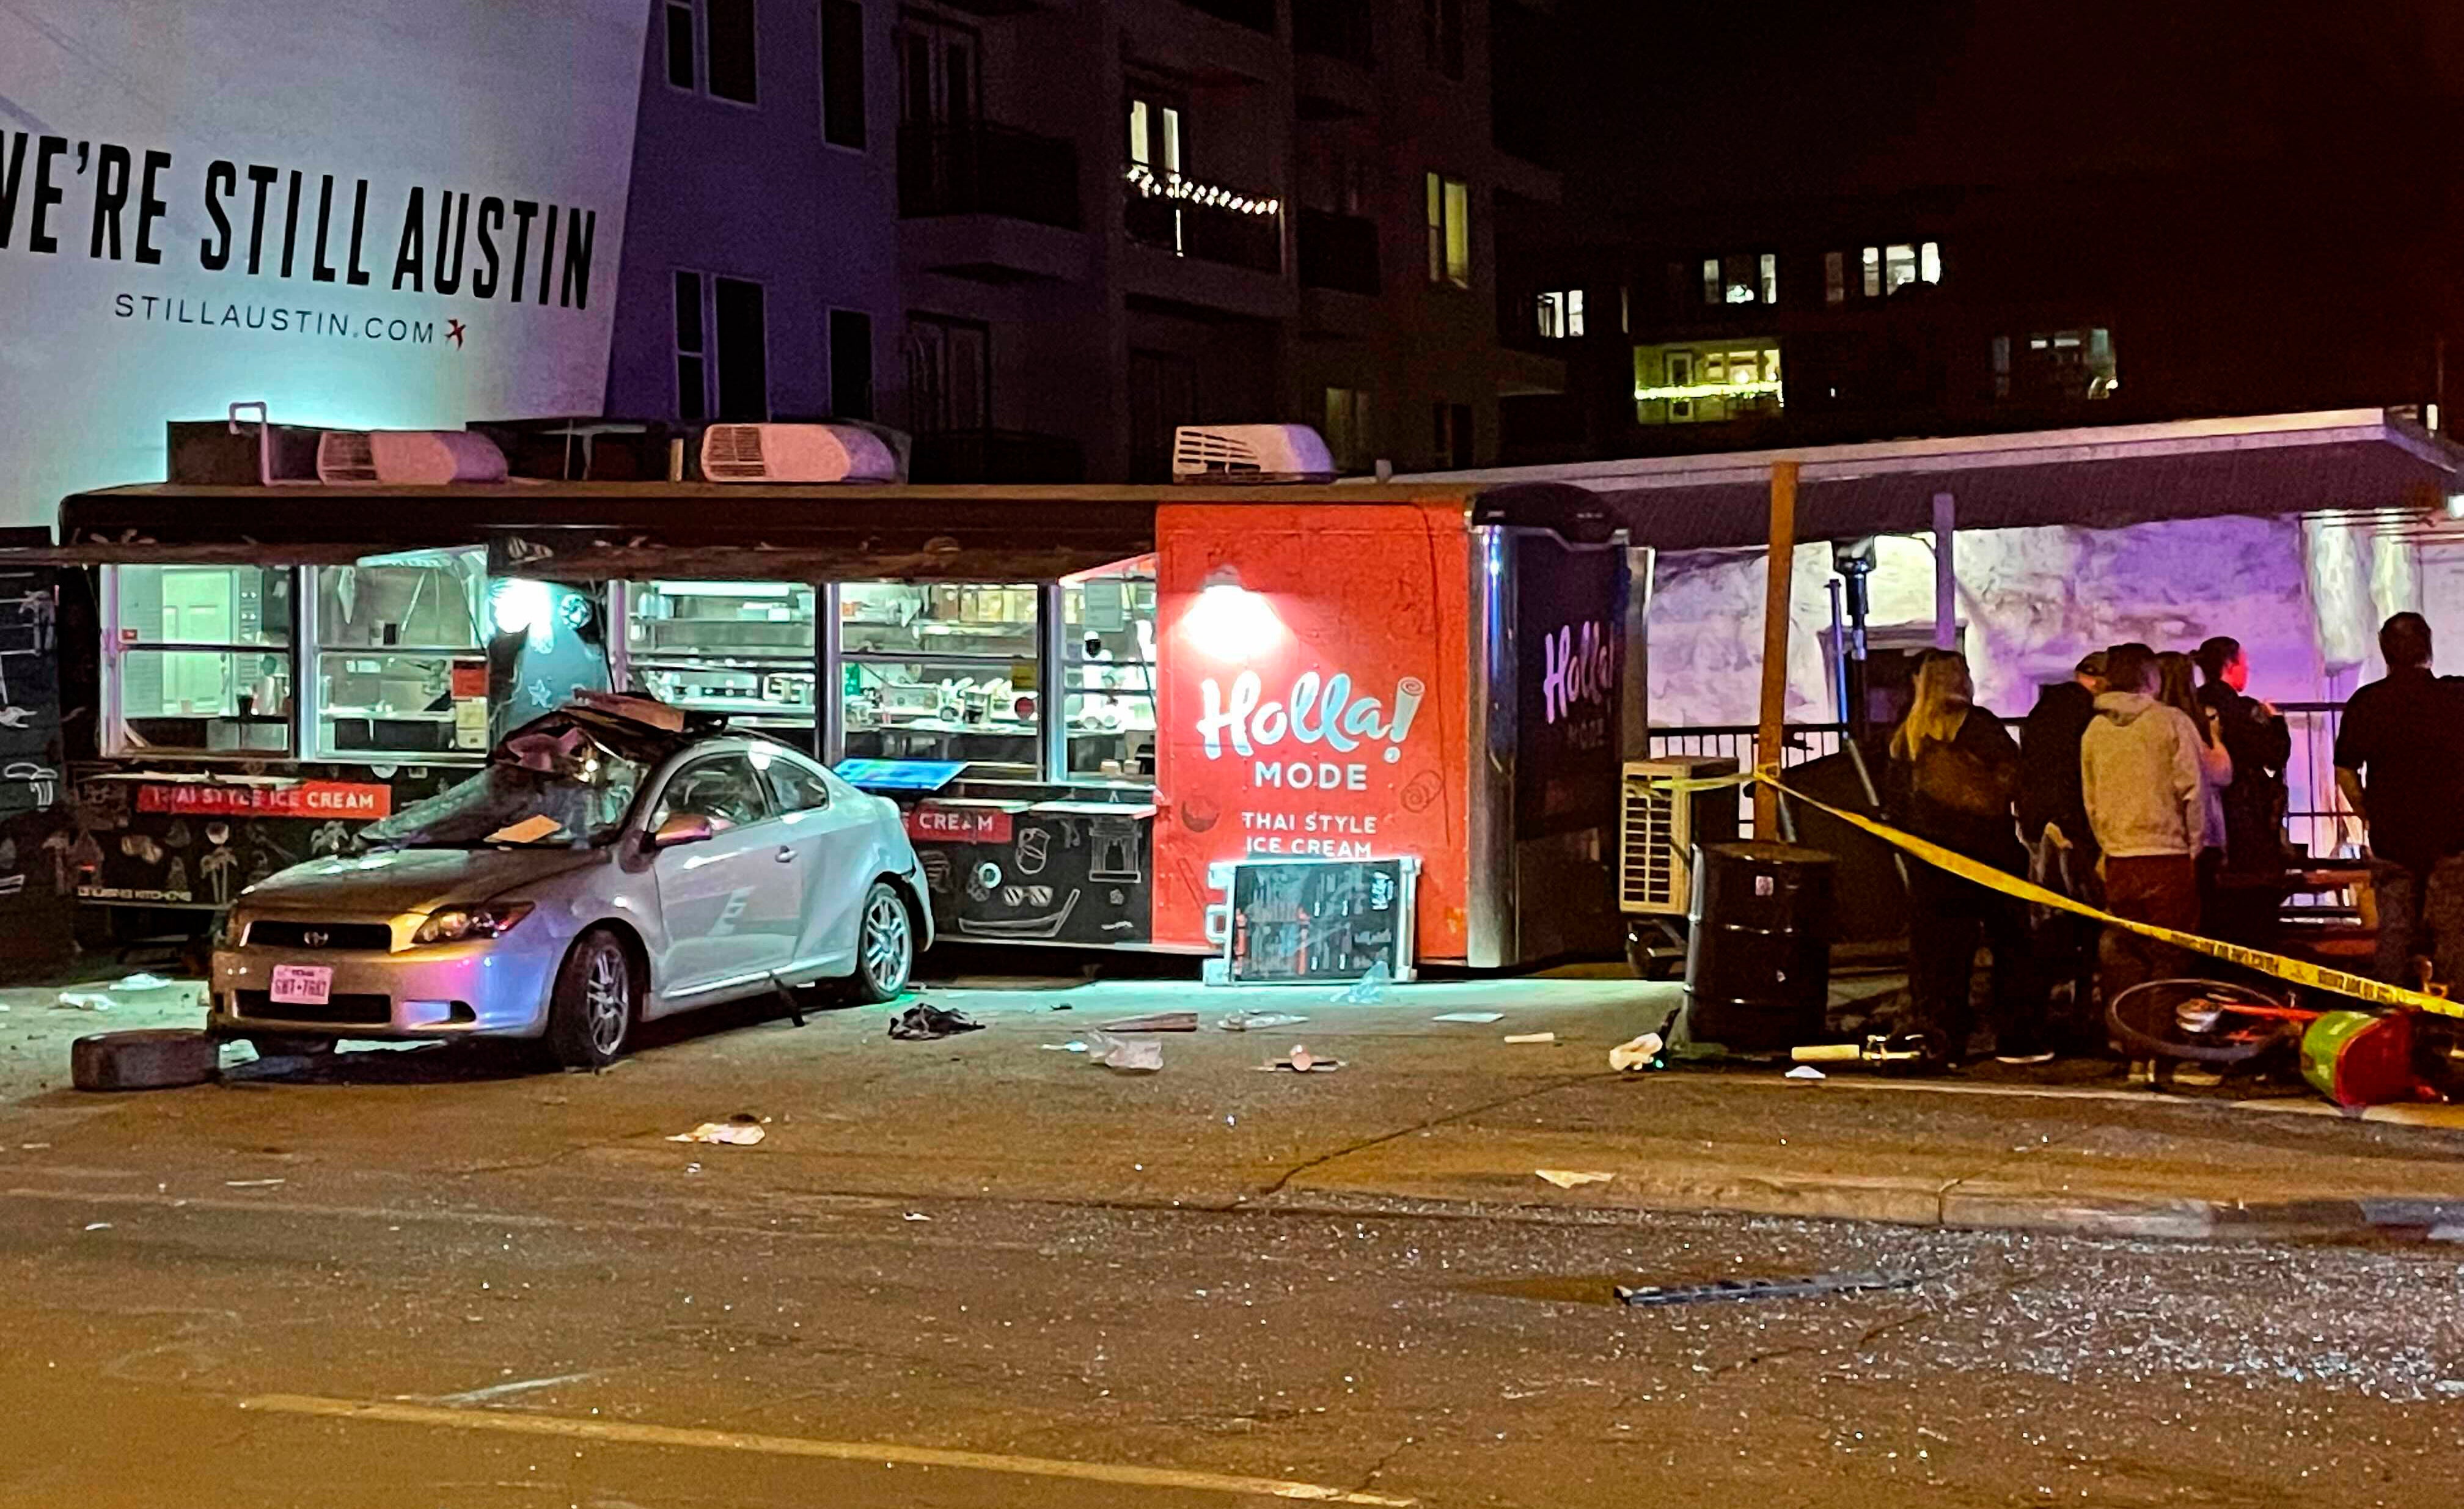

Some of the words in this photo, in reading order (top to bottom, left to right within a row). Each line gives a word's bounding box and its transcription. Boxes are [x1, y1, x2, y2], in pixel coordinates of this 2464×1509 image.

[200, 160, 370, 287] STILL
[392, 186, 596, 310] AUSTIN
[114, 293, 435, 344] STILLAUSTIN.COM
[1543, 620, 1615, 725] Holla!
[1196, 670, 1425, 764] Holla!
[1255, 760, 1368, 791] MODE
[270, 790, 301, 807] ICE
[307, 791, 374, 810] CREAM
[1242, 811, 1296, 831] THAI
[1305, 812, 1378, 834] STYLE
[1246, 836, 1282, 854] ICE
[1290, 837, 1371, 858] CREAM
